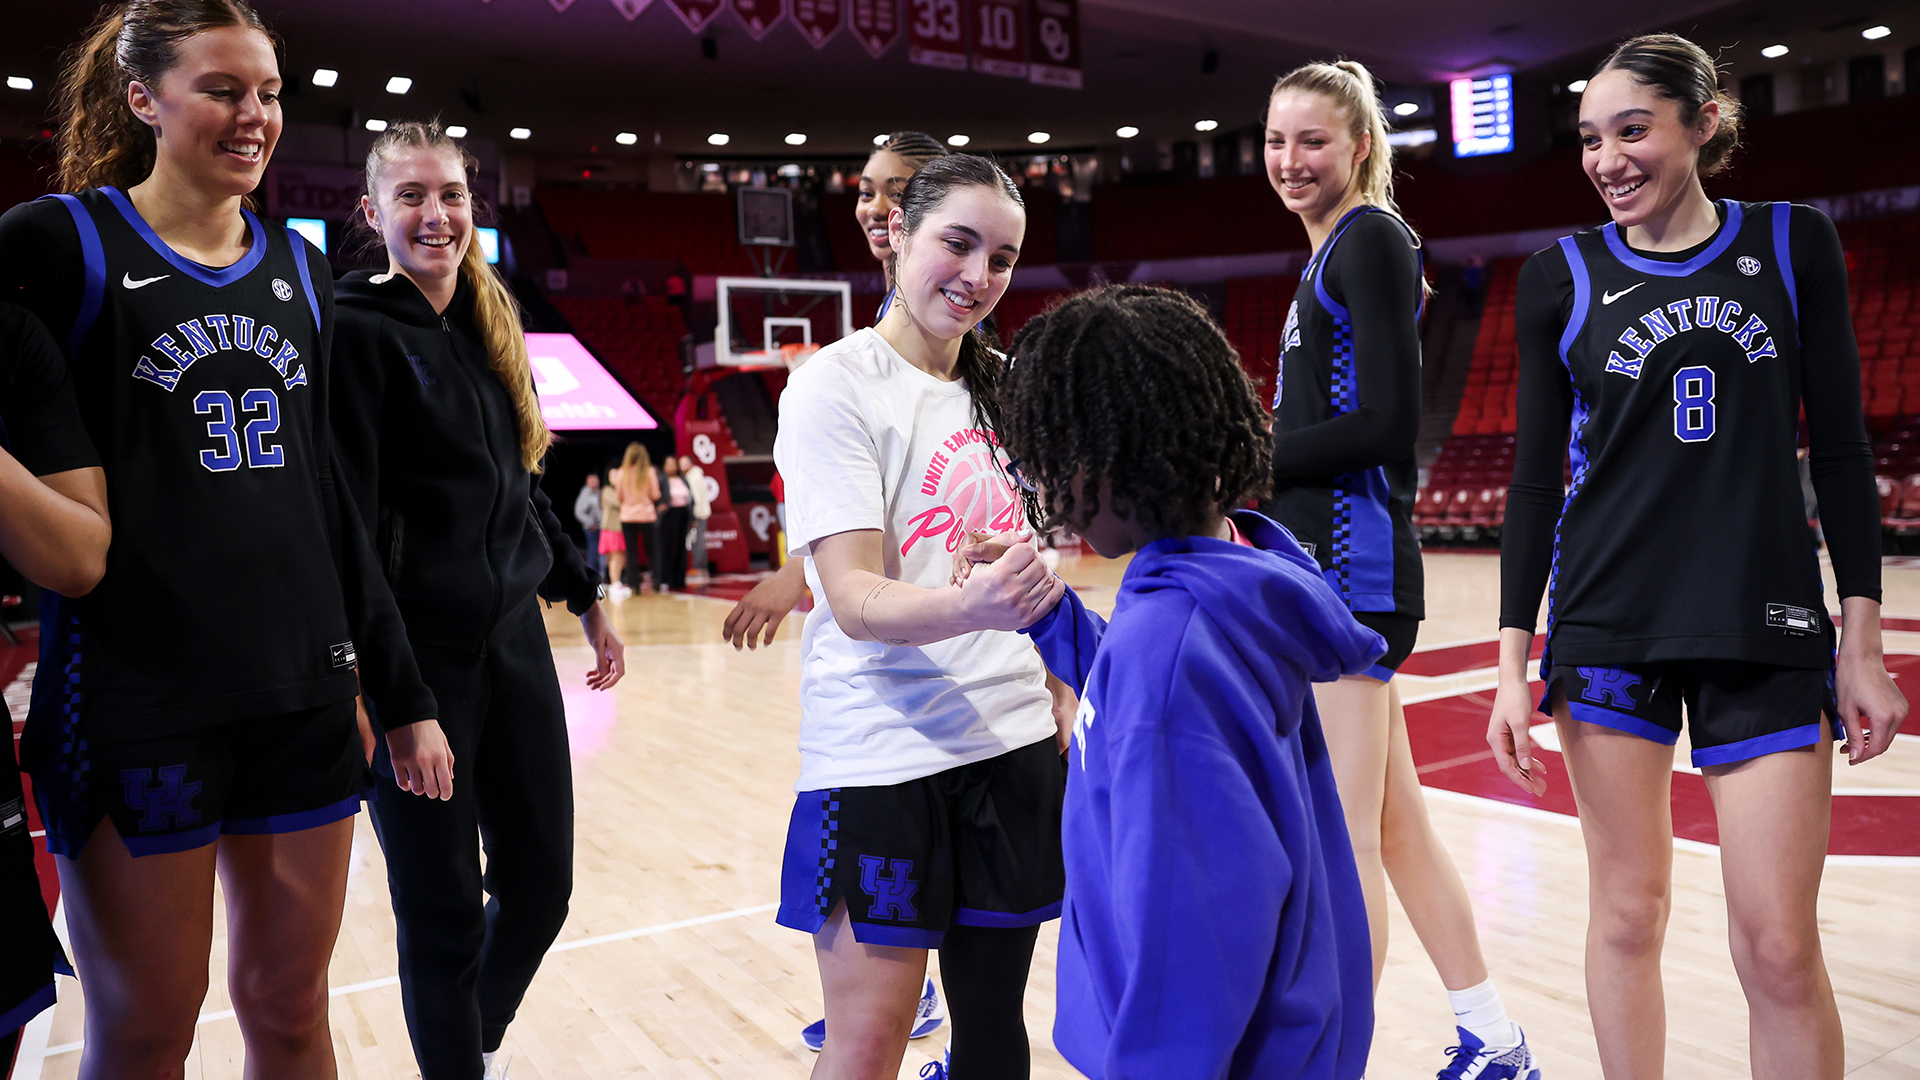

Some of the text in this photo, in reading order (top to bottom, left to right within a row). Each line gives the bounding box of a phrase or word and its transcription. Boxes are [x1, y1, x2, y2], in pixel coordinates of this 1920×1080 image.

[912, 0, 961, 42] 33
[978, 4, 1016, 51] 10
[1039, 16, 1071, 62] OU
[272, 279, 293, 301] SEC
[1738, 257, 1760, 274] SEC
[132, 314, 308, 393] KENTUCKY
[1604, 295, 1778, 380] KENTUCKY
[193, 388, 285, 473] 32
[1673, 365, 1716, 443] 8
[692, 434, 717, 465] OU
[921, 428, 1004, 497] UNITE EMPOWE
[119, 763, 203, 833] UK
[858, 854, 920, 921] UK
